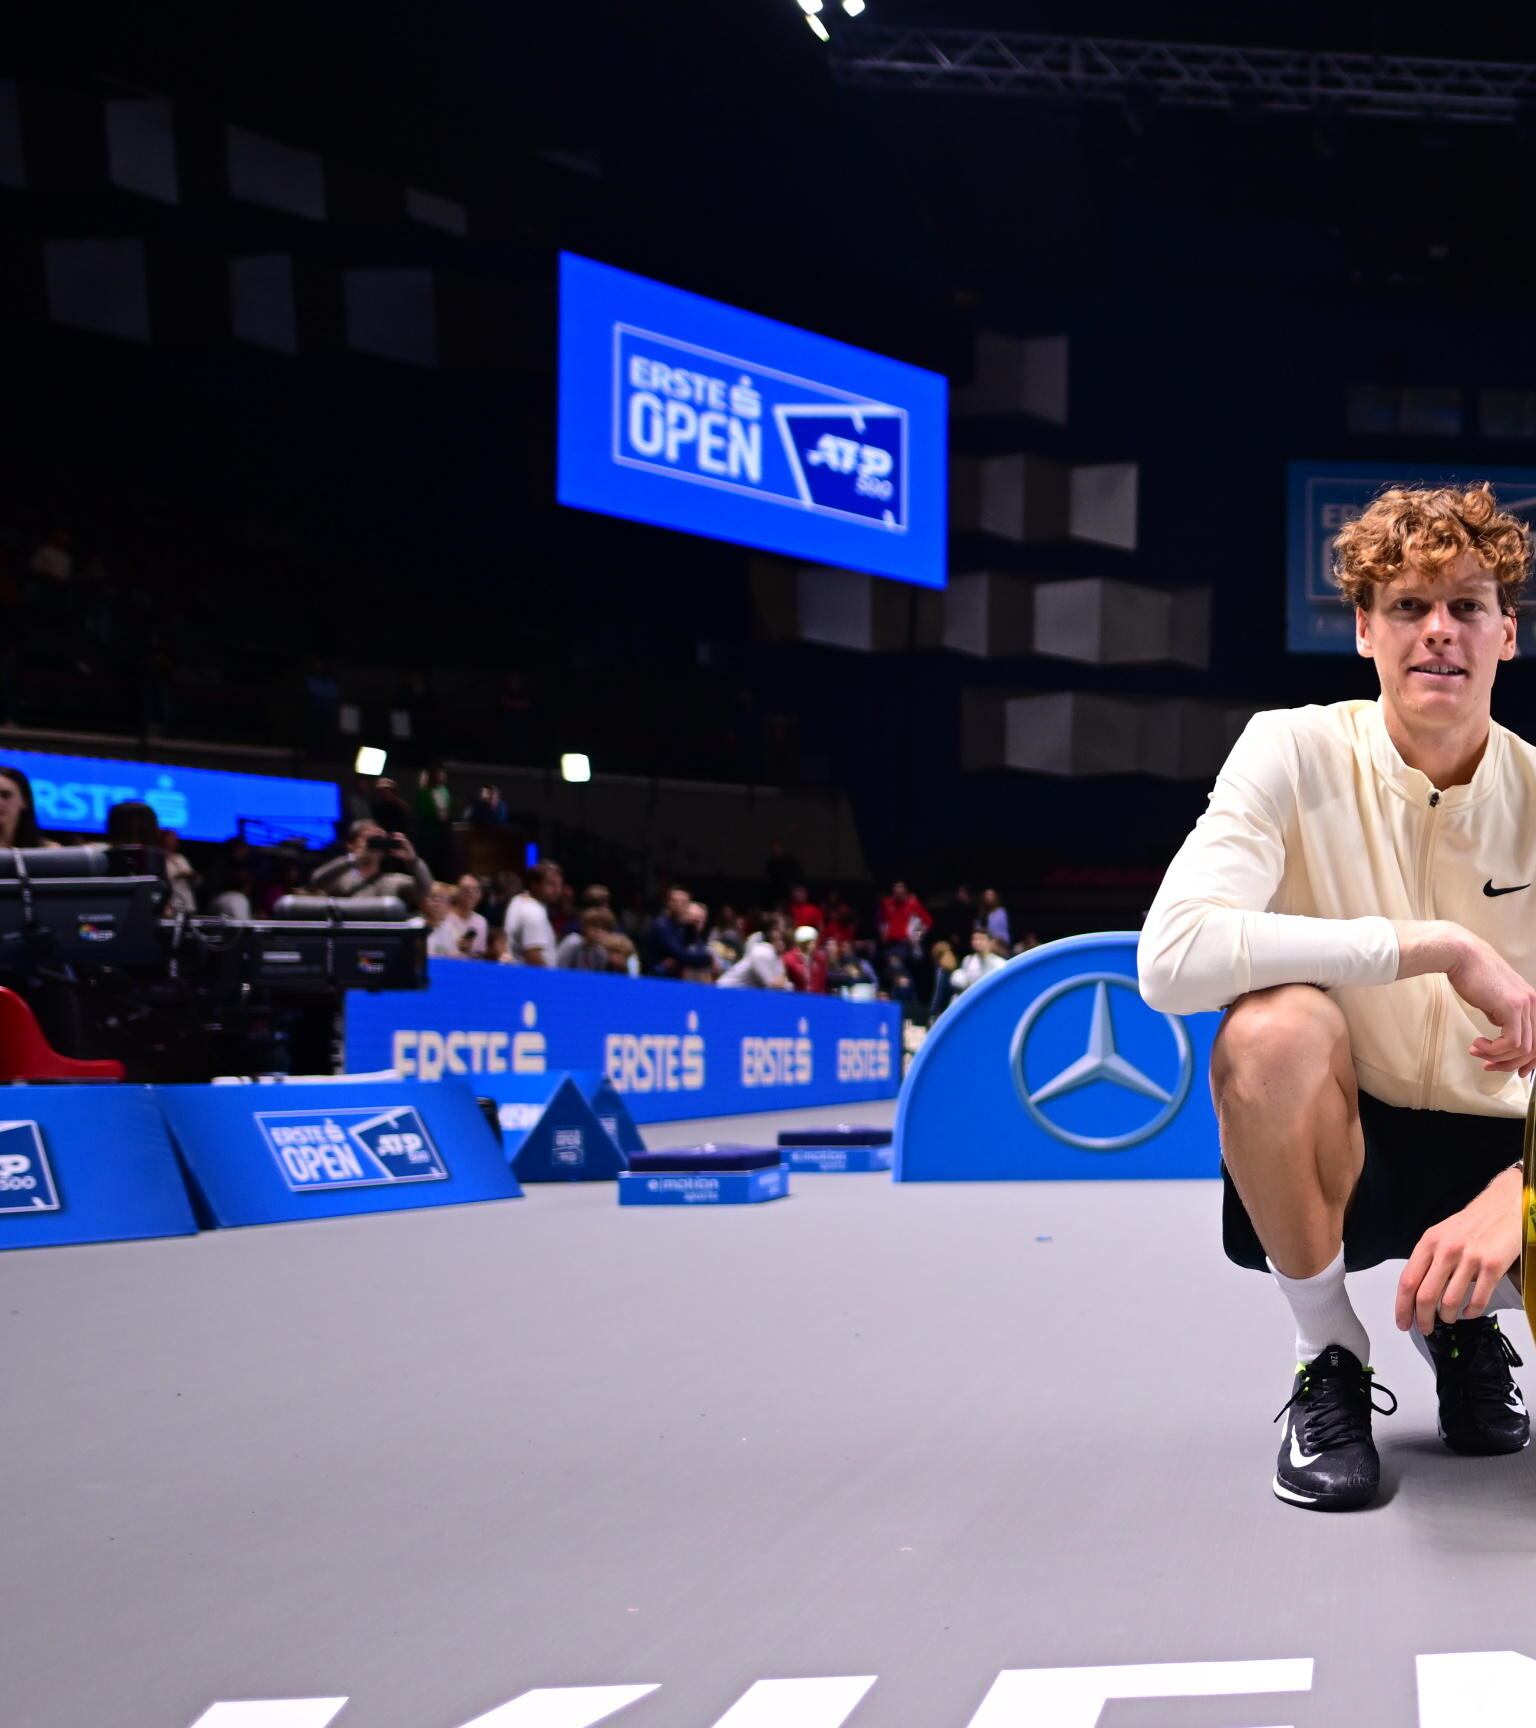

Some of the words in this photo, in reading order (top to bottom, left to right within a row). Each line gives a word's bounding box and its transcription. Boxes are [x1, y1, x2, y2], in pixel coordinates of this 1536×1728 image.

[629, 355, 727, 412] ERSTE
[629, 391, 763, 485] OPEN
[807, 433, 894, 479] ATP
[856, 474, 894, 500] 500
[393, 1029, 509, 1083] ERSTE
[604, 1033, 681, 1092] ERSTE
[740, 1036, 796, 1088] ERSTE
[270, 1125, 327, 1148] ERSTE
[376, 1132, 423, 1157] ATP
[280, 1143, 364, 1183] OPEN
